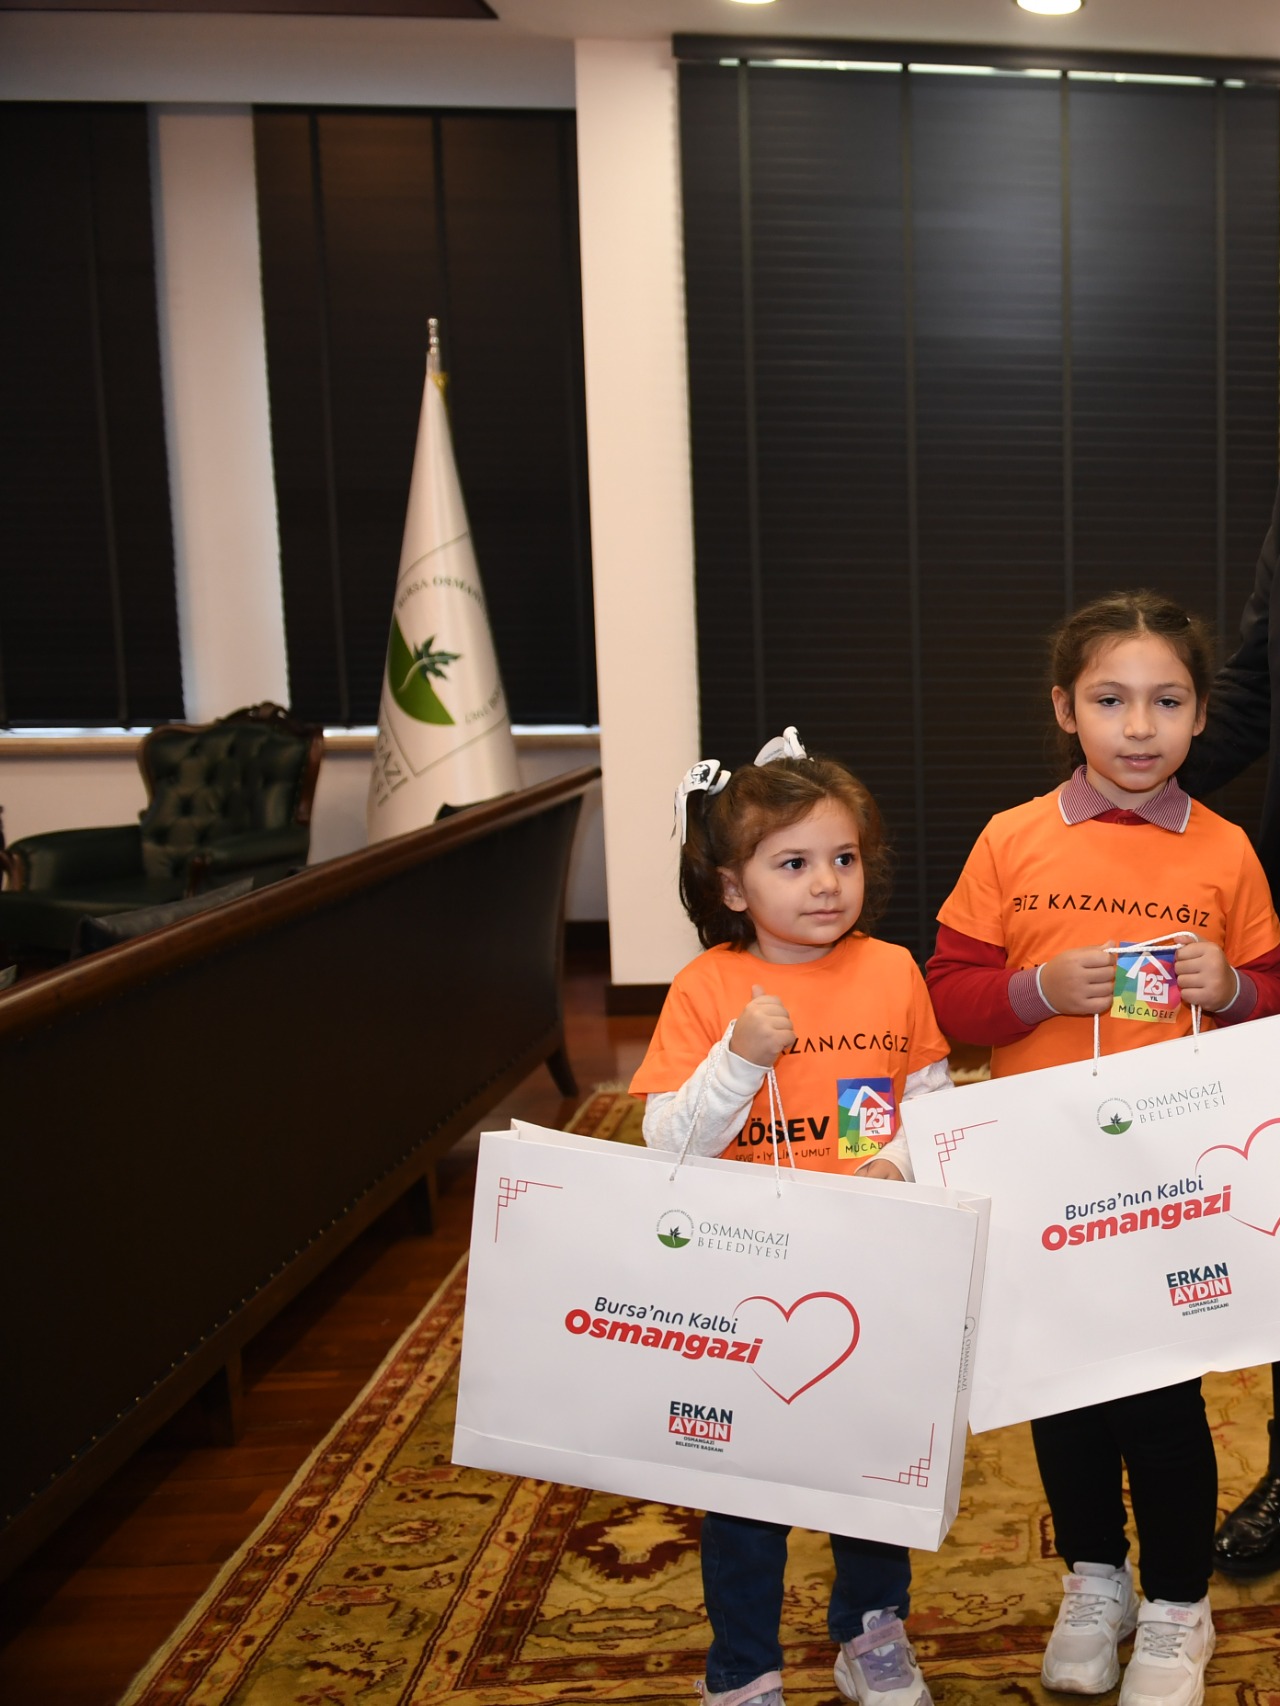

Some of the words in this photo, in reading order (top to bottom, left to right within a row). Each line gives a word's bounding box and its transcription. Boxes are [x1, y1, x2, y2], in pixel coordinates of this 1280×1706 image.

[1048, 893, 1210, 928] KAZANACAĞIZ
[1144, 973, 1164, 995] 25
[1118, 1004, 1175, 1019] MÜCADELE
[781, 1030, 909, 1056] ZANACAĞIZ
[1135, 1080, 1223, 1111] OSMANGAZİ
[866, 1107, 885, 1128] 25
[1139, 1095, 1226, 1125] BELEDİYESİ
[737, 1115, 830, 1147] LÖSEV
[801, 1147, 831, 1159] UMUT
[1065, 1189, 1152, 1220] Bursa'nın
[1157, 1174, 1204, 1201] Kalbi
[1041, 1184, 1232, 1251] Osmangazi
[699, 1221, 789, 1247] OSMANGAZİ
[697, 1236, 788, 1260] BELEDİYESİ
[1166, 1261, 1229, 1289] ERKAN
[1173, 1278, 1230, 1305] AYDIN
[594, 1296, 684, 1325] Bursa'nın
[688, 1311, 738, 1334] Kalbi
[564, 1308, 763, 1365] Osmangazi
[669, 1400, 733, 1425] ERKAN
[670, 1416, 729, 1440] AYDIN
